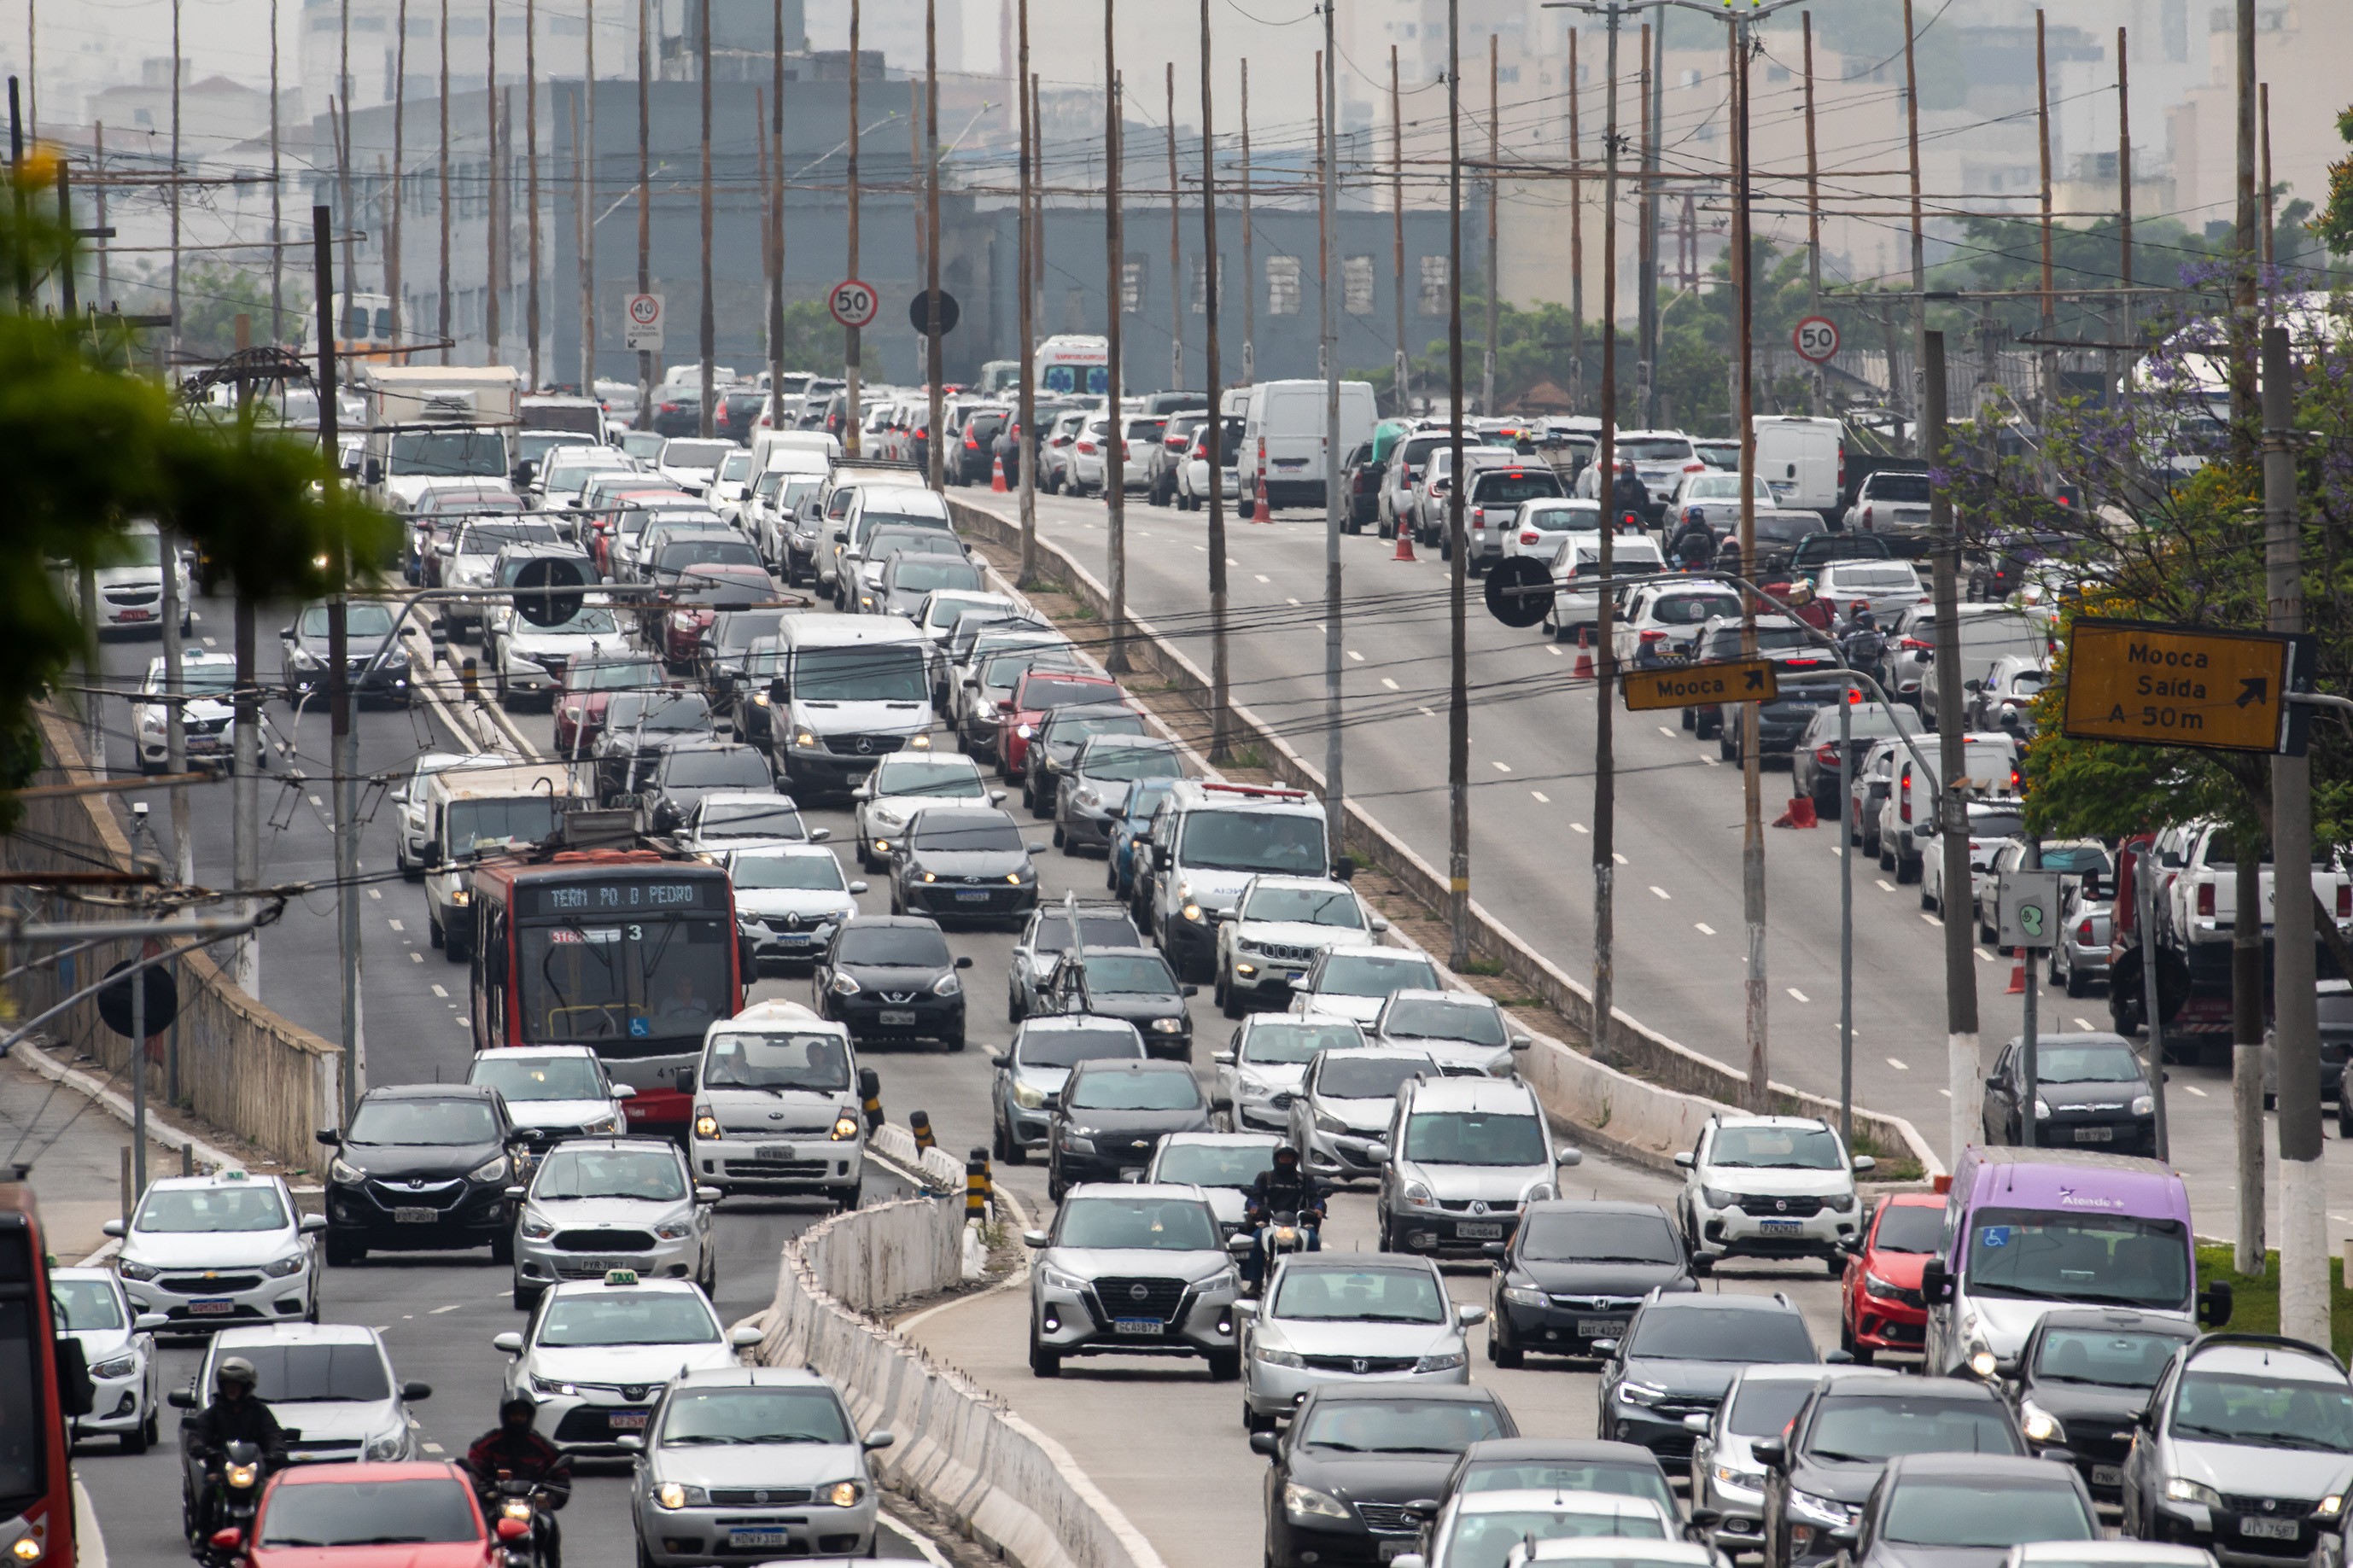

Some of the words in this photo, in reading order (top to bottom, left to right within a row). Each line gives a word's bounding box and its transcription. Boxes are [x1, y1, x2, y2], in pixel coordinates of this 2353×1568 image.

[634, 302, 654, 315] 40
[838, 291, 868, 312] 50
[1802, 328, 1832, 348] 50
[2128, 643, 2209, 668] Mooca
[1656, 679, 1725, 697] Mooca
[2136, 675, 2207, 699] Saída
[2108, 704, 2126, 724] A
[649, 884, 693, 904] PEDRO
[628, 924, 642, 941] 3
[610, 1272, 634, 1283] TAXI
